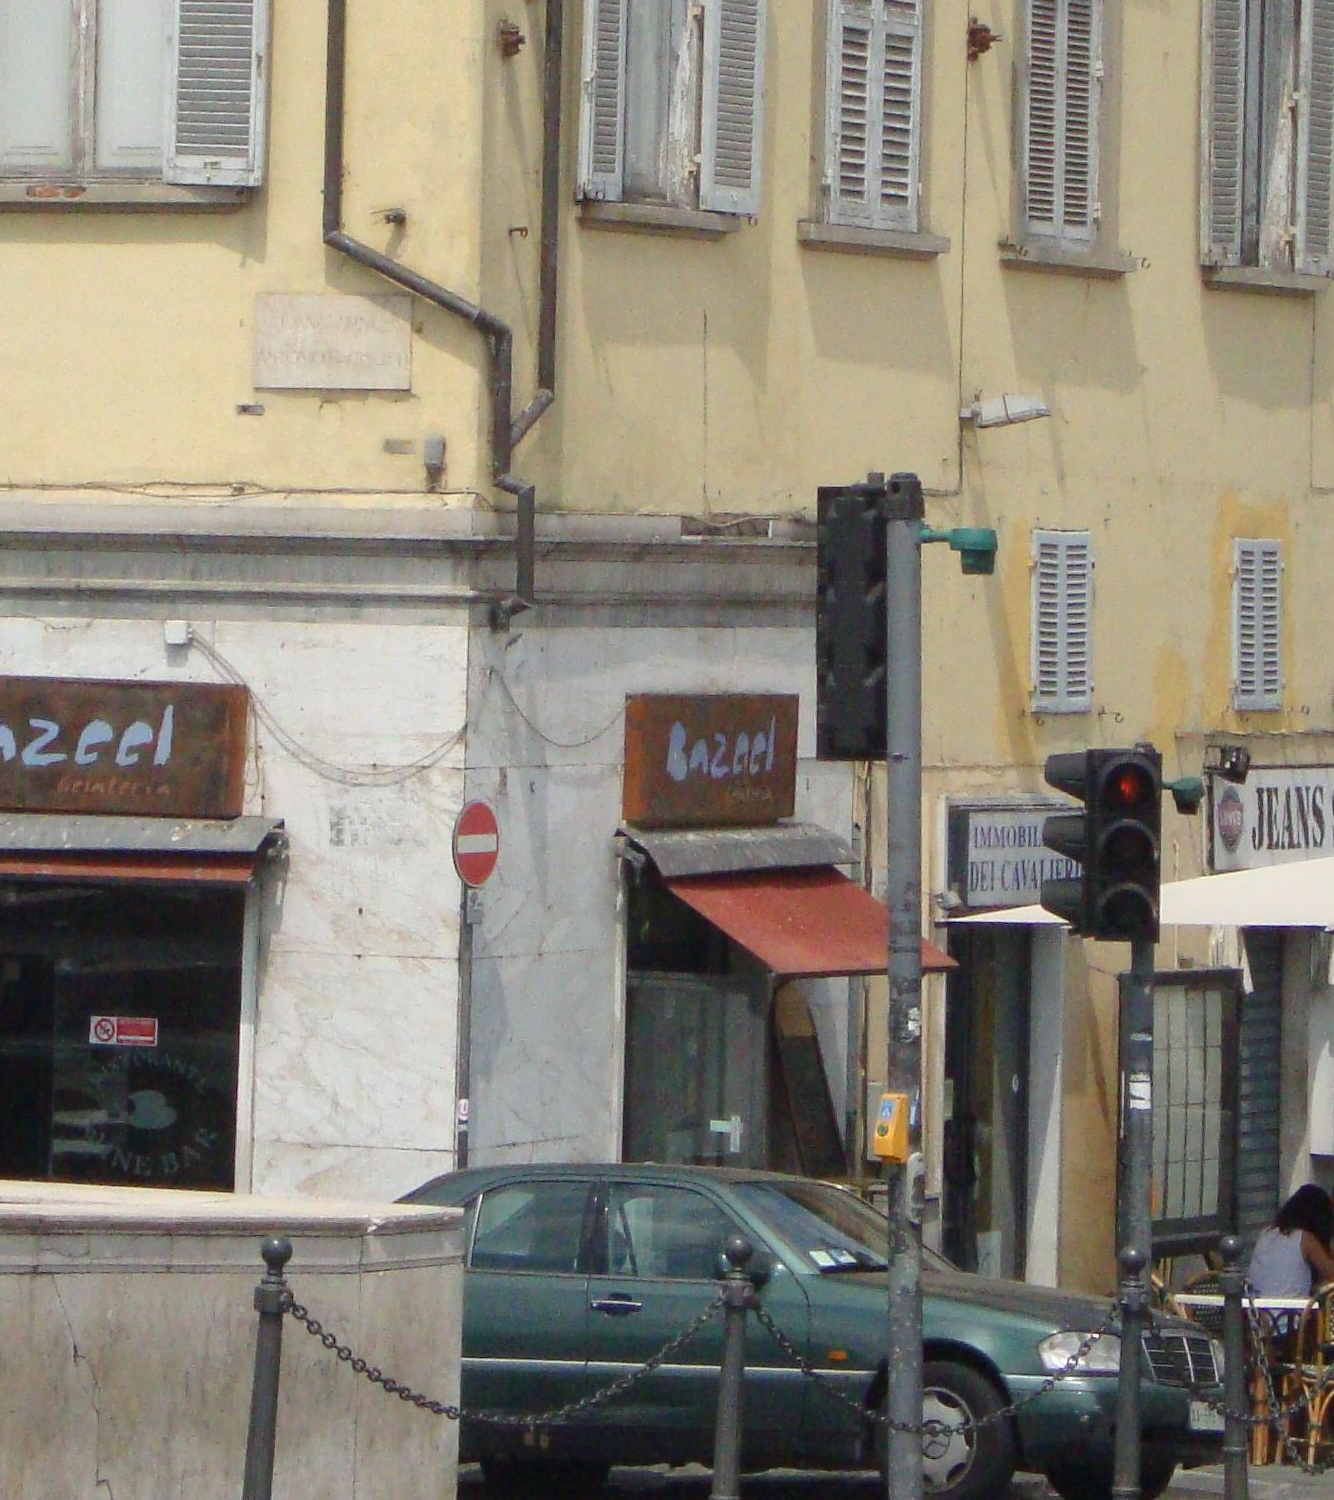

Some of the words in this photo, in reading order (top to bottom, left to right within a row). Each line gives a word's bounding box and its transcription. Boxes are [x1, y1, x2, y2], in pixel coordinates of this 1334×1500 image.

[667, 715, 777, 781] Bazeel
[974, 825, 1042, 849] IMMOBIL
[1251, 786, 1326, 850] JEANS
[970, 856, 995, 887] DEI
